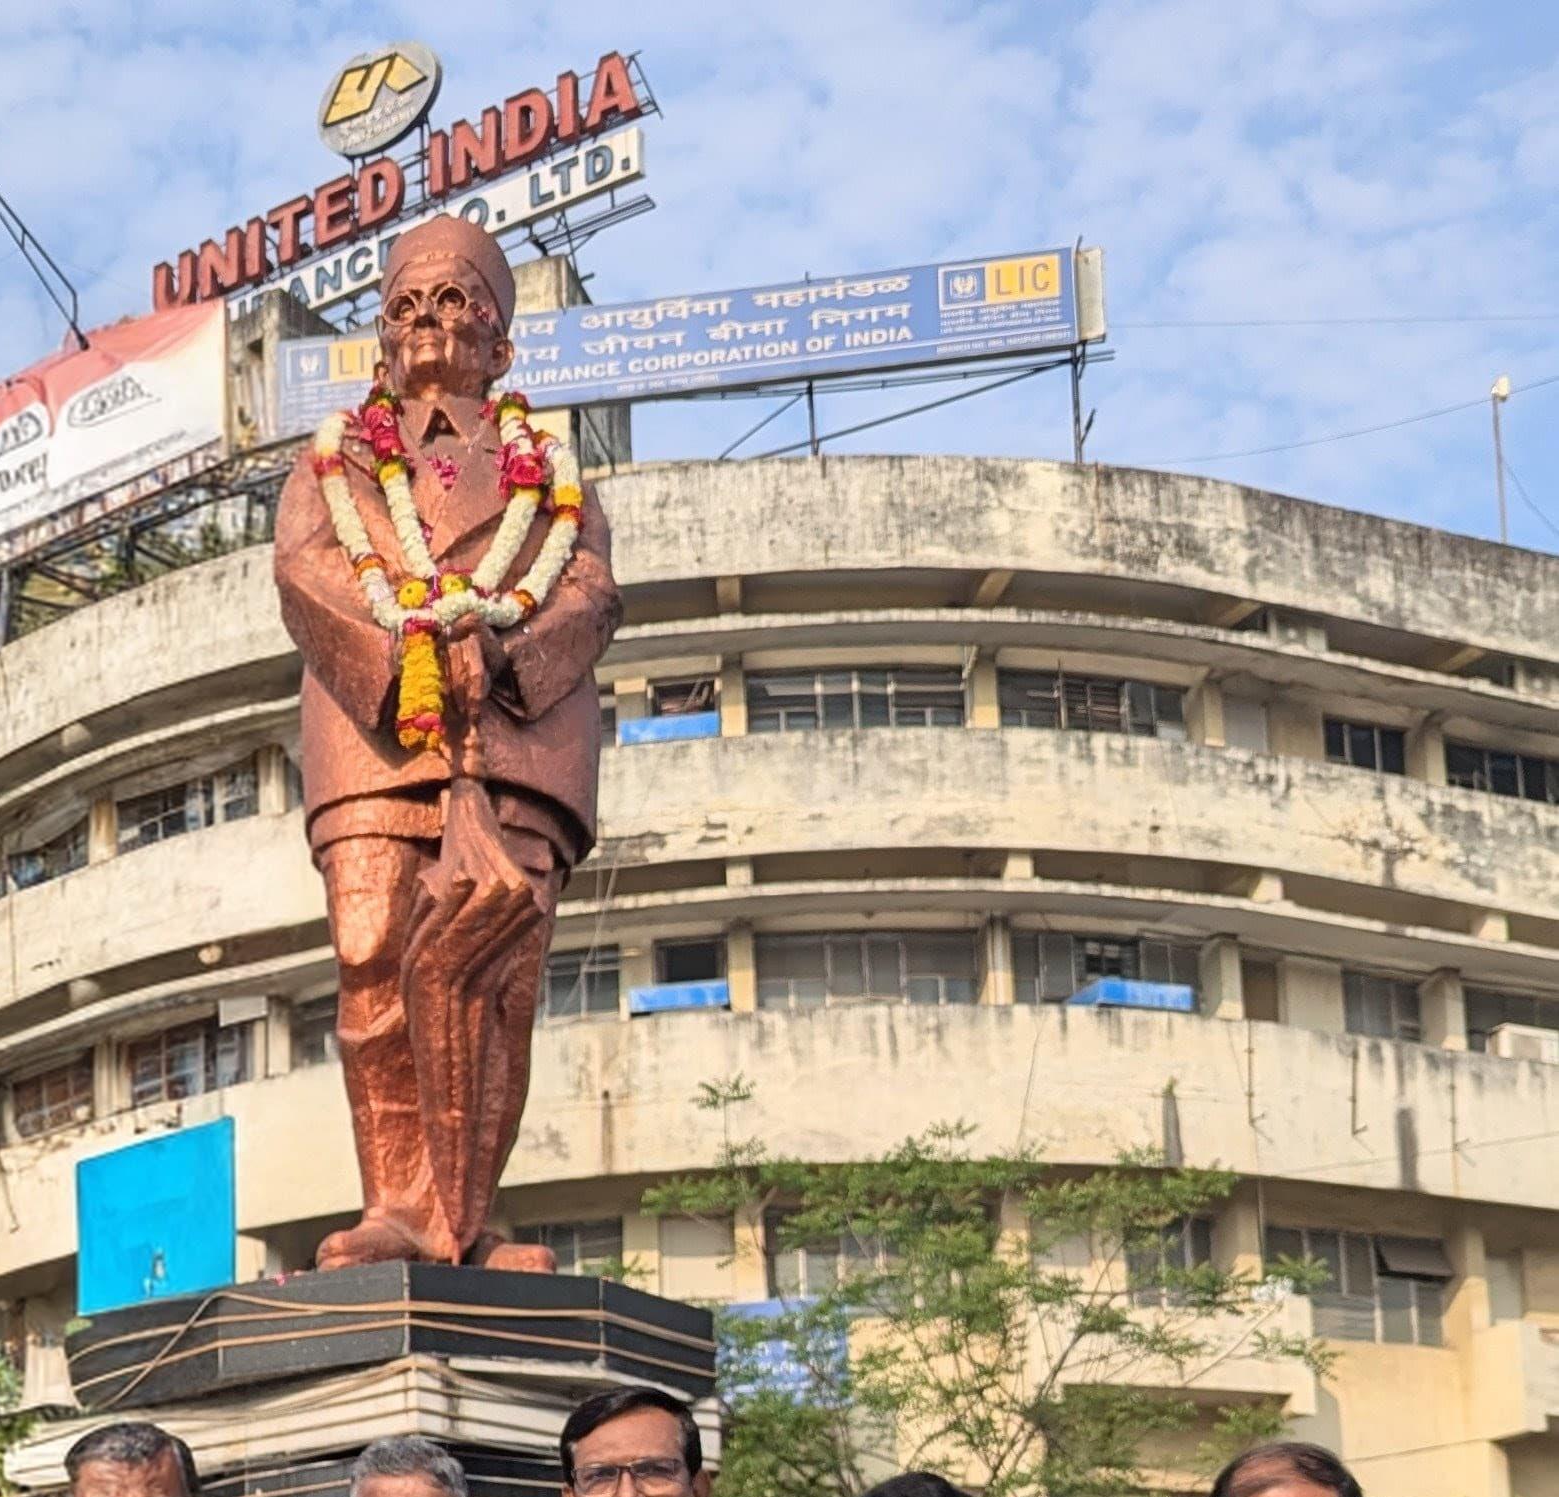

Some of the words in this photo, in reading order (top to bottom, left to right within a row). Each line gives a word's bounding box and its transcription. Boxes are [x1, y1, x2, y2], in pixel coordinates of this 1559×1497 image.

[153, 156, 405, 312] UNITED
[429, 51, 642, 198] INDIA
[529, 145, 631, 209] LTD.
[995, 262, 1050, 296] LIC
[628, 339, 799, 375] CORPORATION
[805, 335, 837, 353] OF
[845, 325, 914, 348] INDIA
